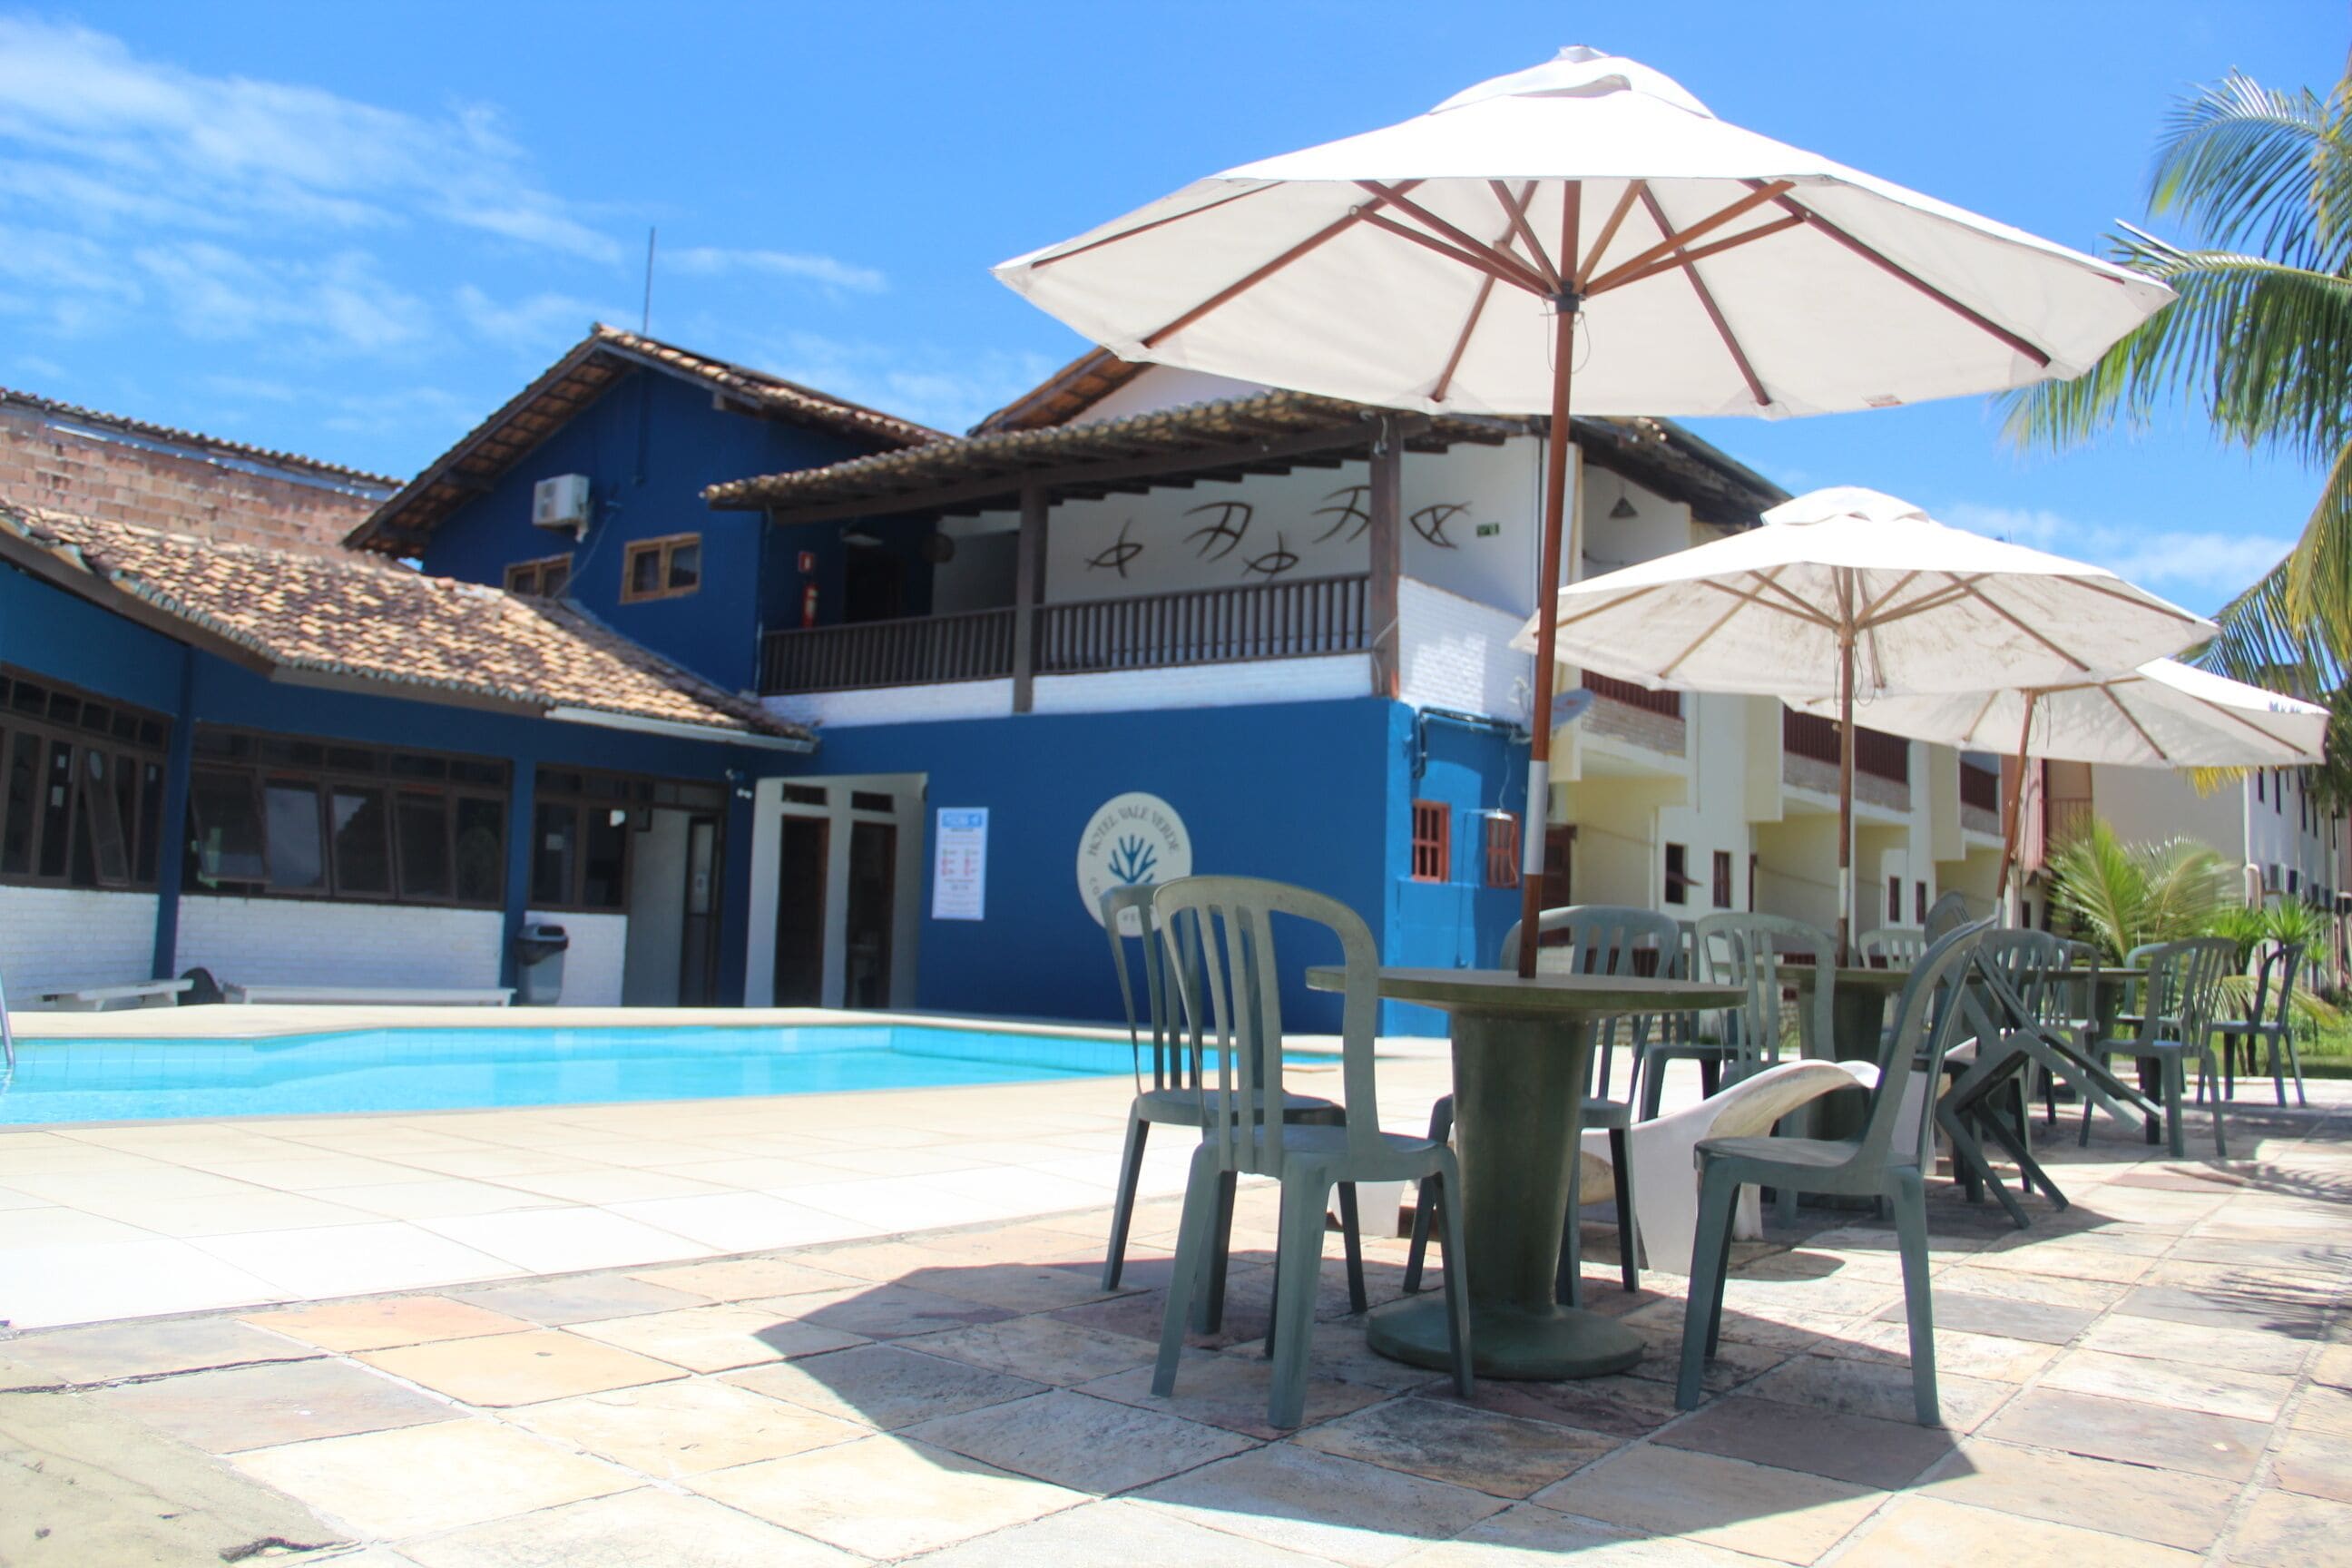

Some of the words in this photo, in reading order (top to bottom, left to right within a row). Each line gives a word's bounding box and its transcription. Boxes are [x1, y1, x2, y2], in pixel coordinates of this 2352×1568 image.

[1088, 814, 1119, 856] HOTEL
[1118, 805, 1148, 820] VALE
[1152, 811, 1179, 854] VERDE
